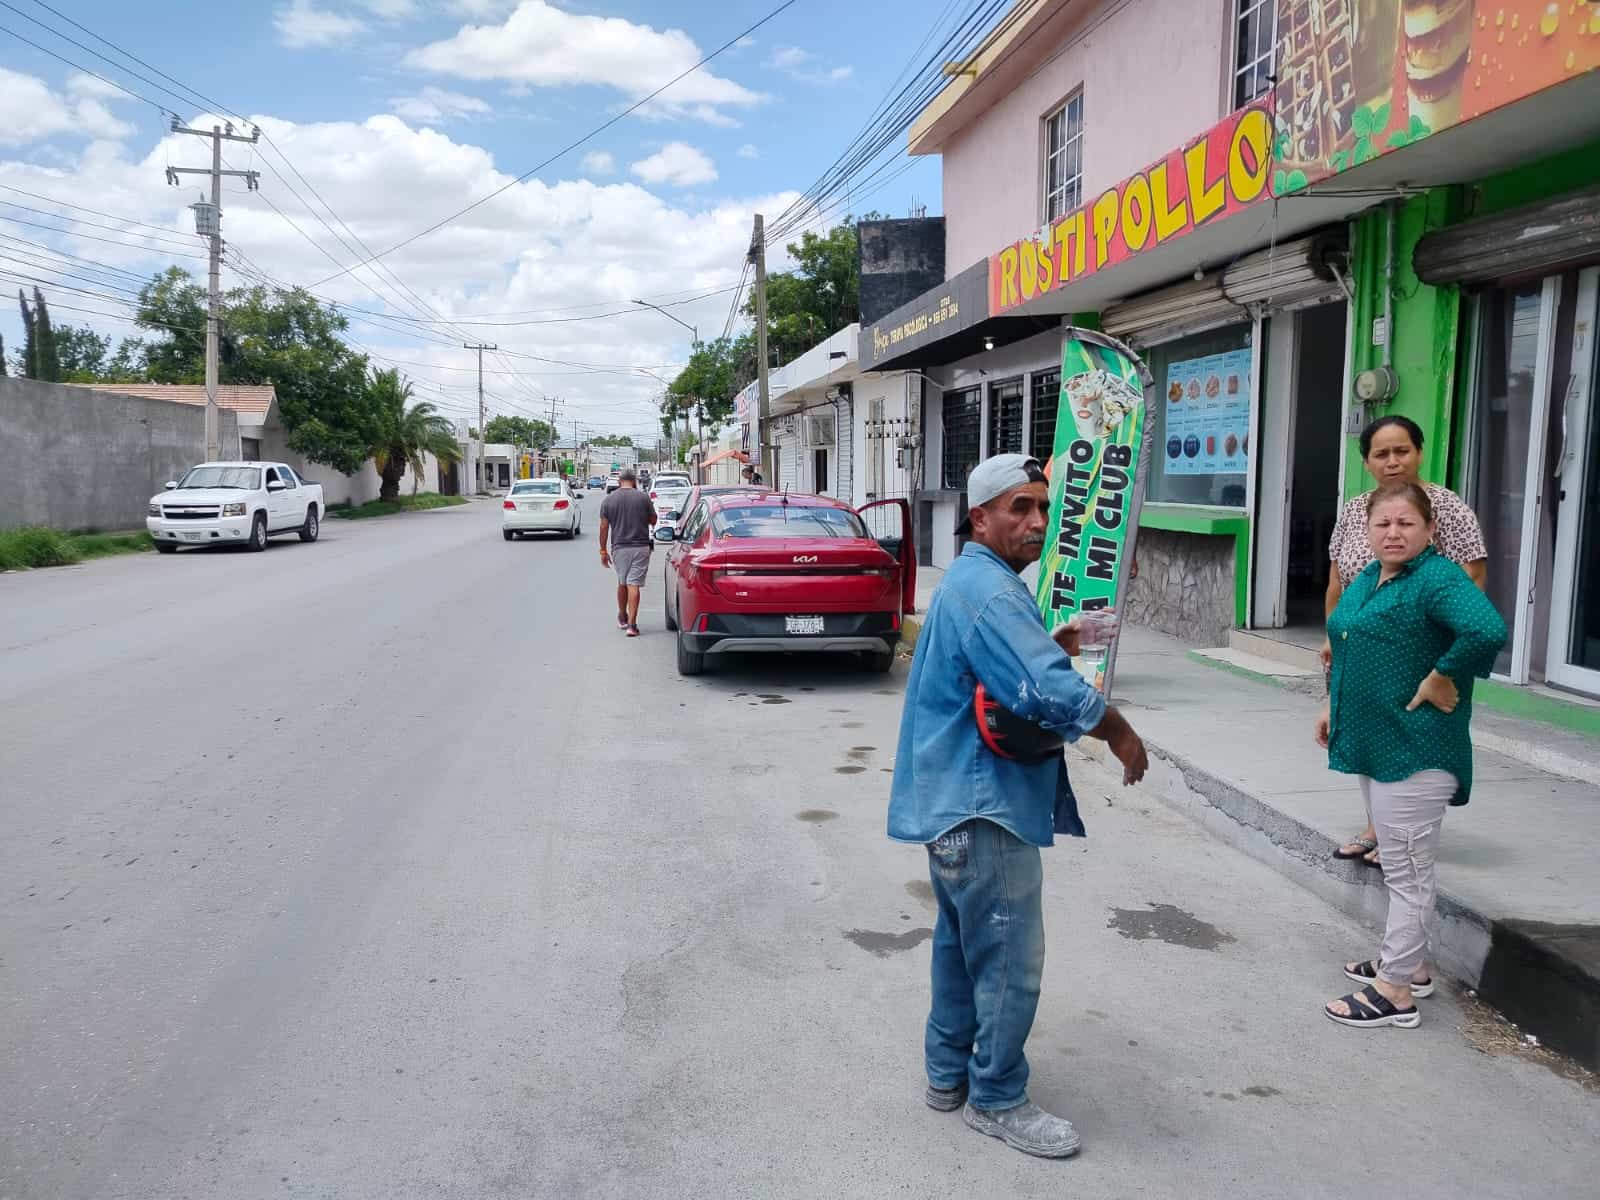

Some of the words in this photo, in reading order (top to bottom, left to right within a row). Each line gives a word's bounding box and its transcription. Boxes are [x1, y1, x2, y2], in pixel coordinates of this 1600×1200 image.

[1000, 211, 1087, 307] ROSTI
[1093, 107, 1274, 271] POLLO
[1059, 439, 1093, 559] INVITO
[1094, 444, 1132, 530] CLUB
[793, 555, 818, 563] KIA
[1086, 536, 1118, 580] MI
[1052, 572, 1076, 610] TE
